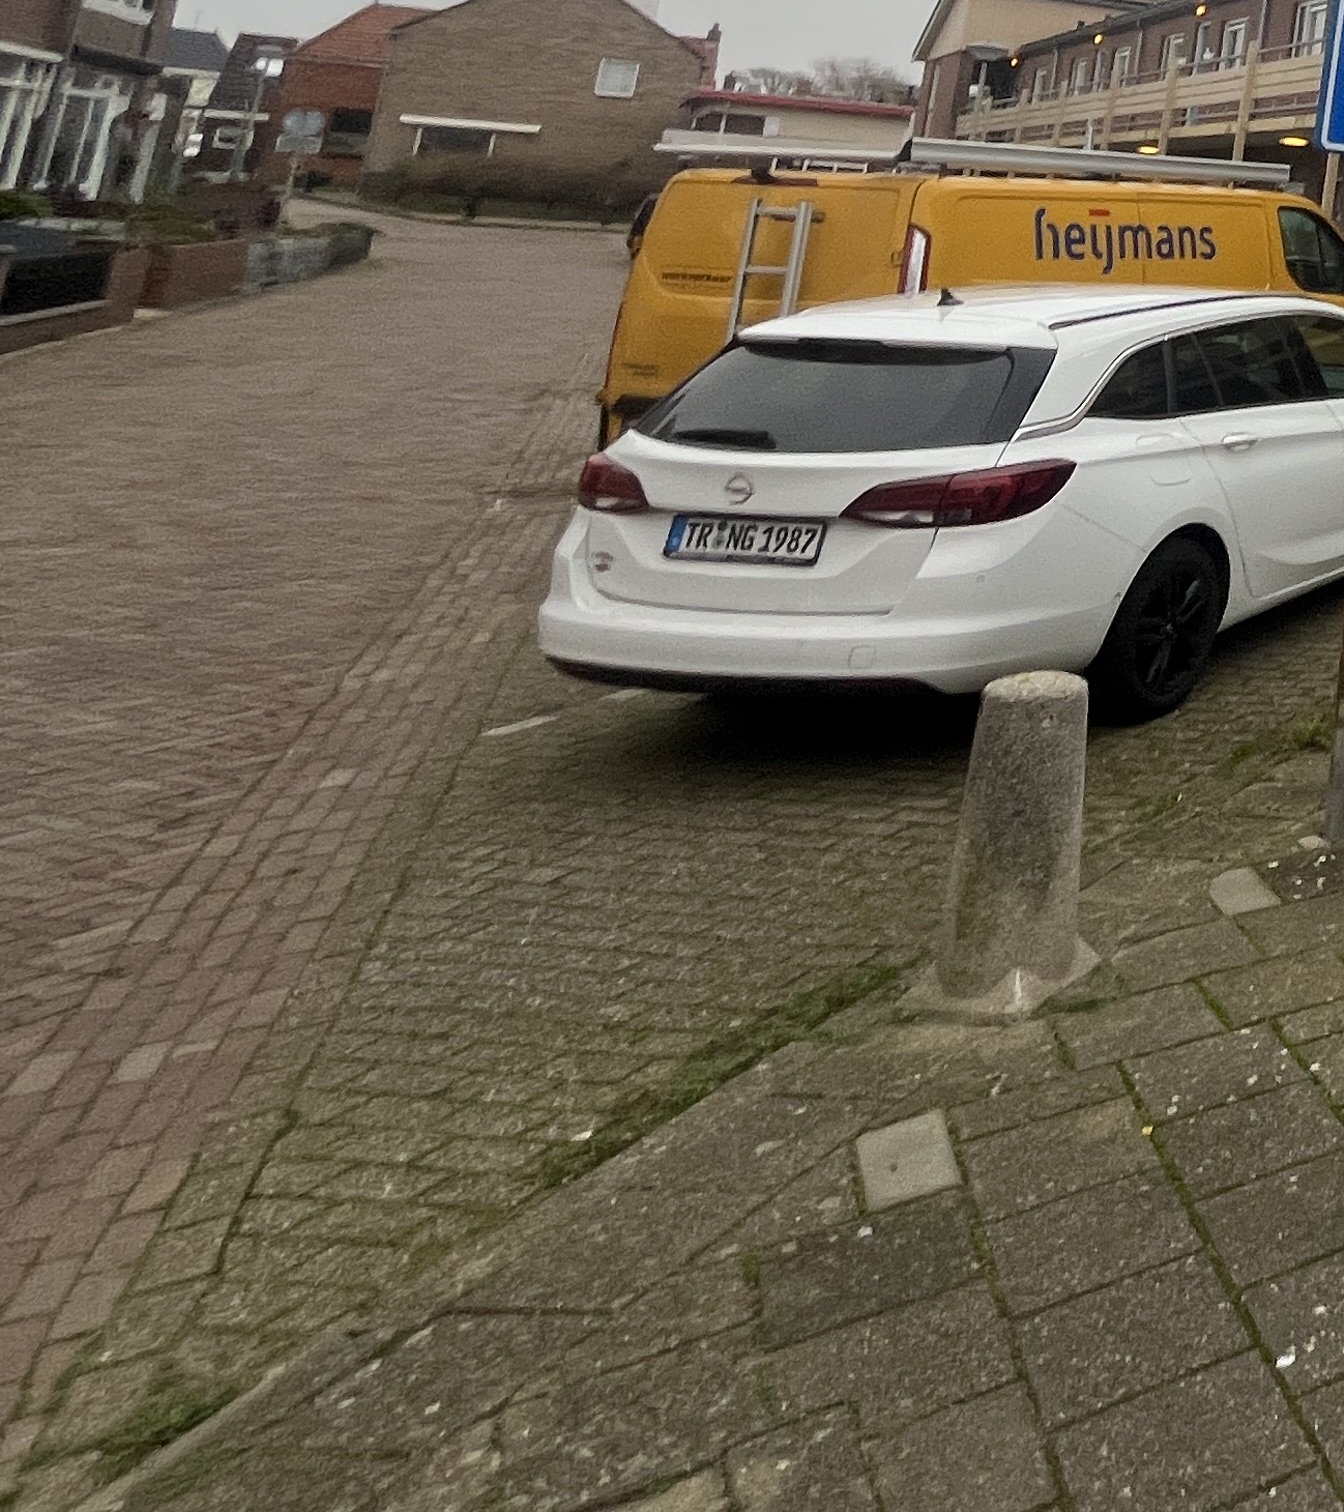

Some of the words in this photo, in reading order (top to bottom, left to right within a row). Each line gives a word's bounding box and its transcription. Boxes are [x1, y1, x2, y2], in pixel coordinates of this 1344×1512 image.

[685, 522, 714, 550] TR
[725, 524, 758, 552] NG
[757, 526, 818, 554] 1987
